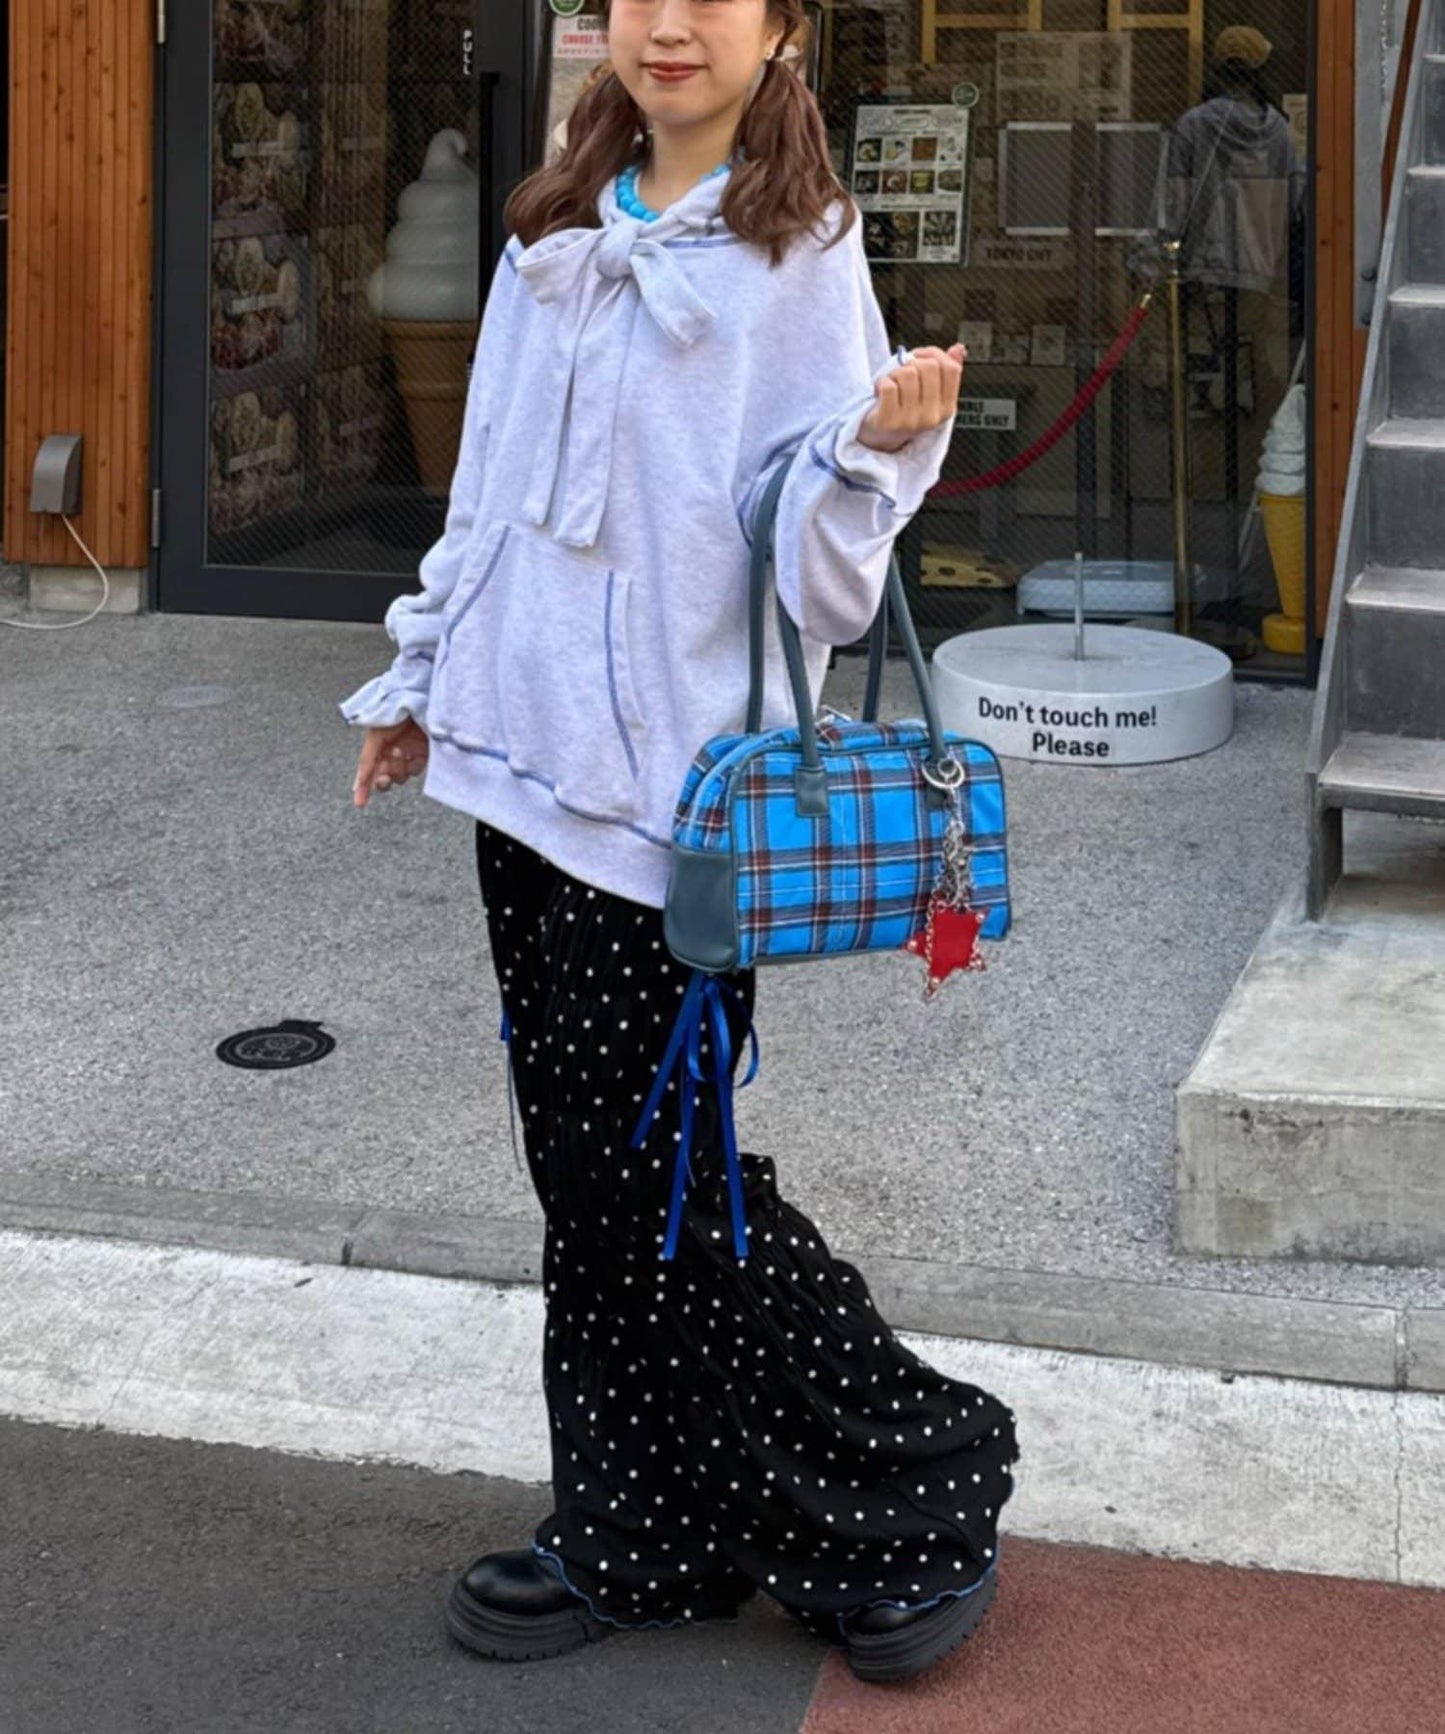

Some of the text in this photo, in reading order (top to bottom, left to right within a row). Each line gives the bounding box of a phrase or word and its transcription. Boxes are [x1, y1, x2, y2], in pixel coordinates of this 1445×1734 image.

[463, 30, 472, 75] PULL
[983, 414, 1009, 427] ONLY
[978, 696, 1157, 728] Don't touch me!
[1032, 732, 1110, 757] Please
